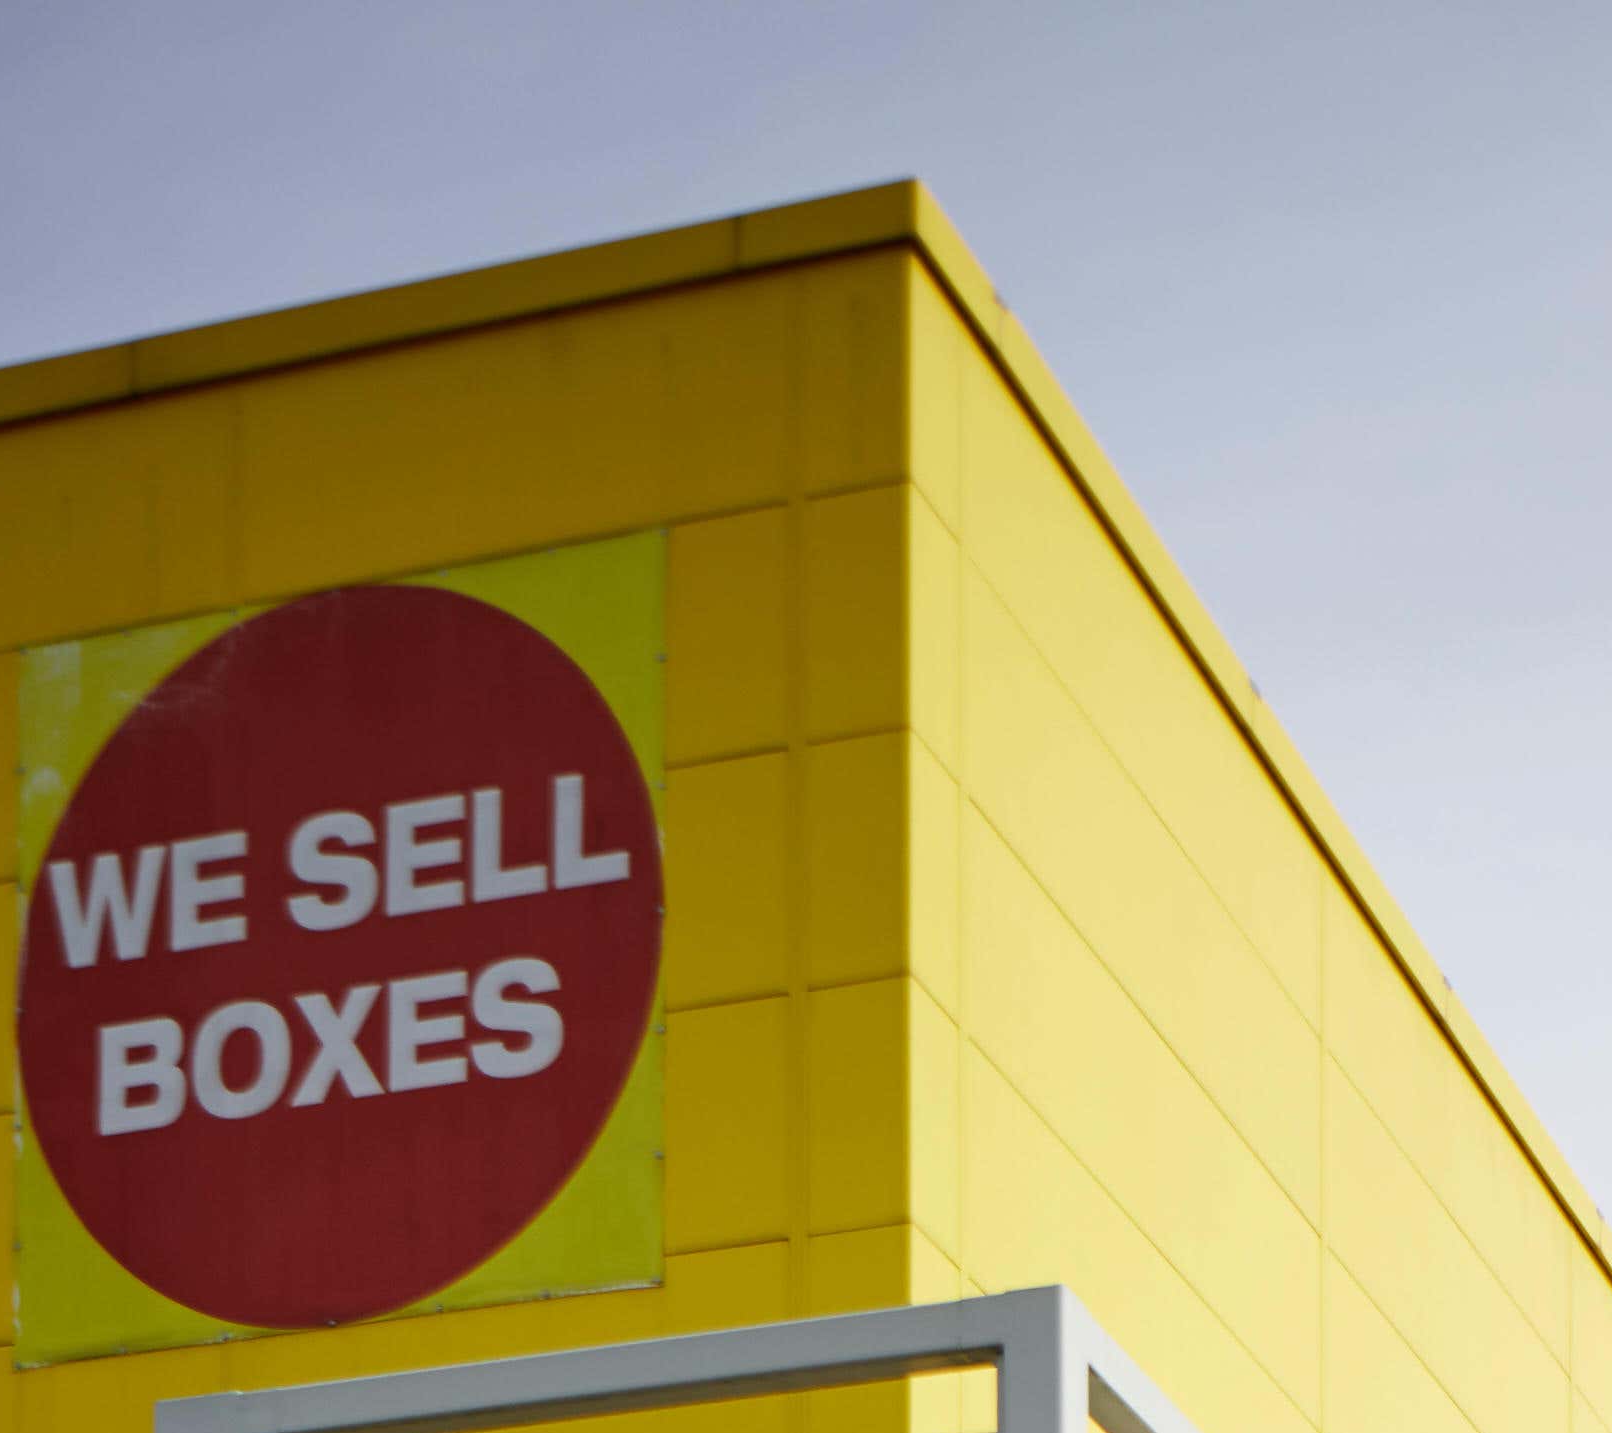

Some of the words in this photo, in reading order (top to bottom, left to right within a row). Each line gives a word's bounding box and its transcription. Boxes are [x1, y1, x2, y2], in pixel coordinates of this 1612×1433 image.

[48, 830, 248, 968] WE
[286, 773, 631, 932] SELL
[97, 957, 565, 1136] BOXES
